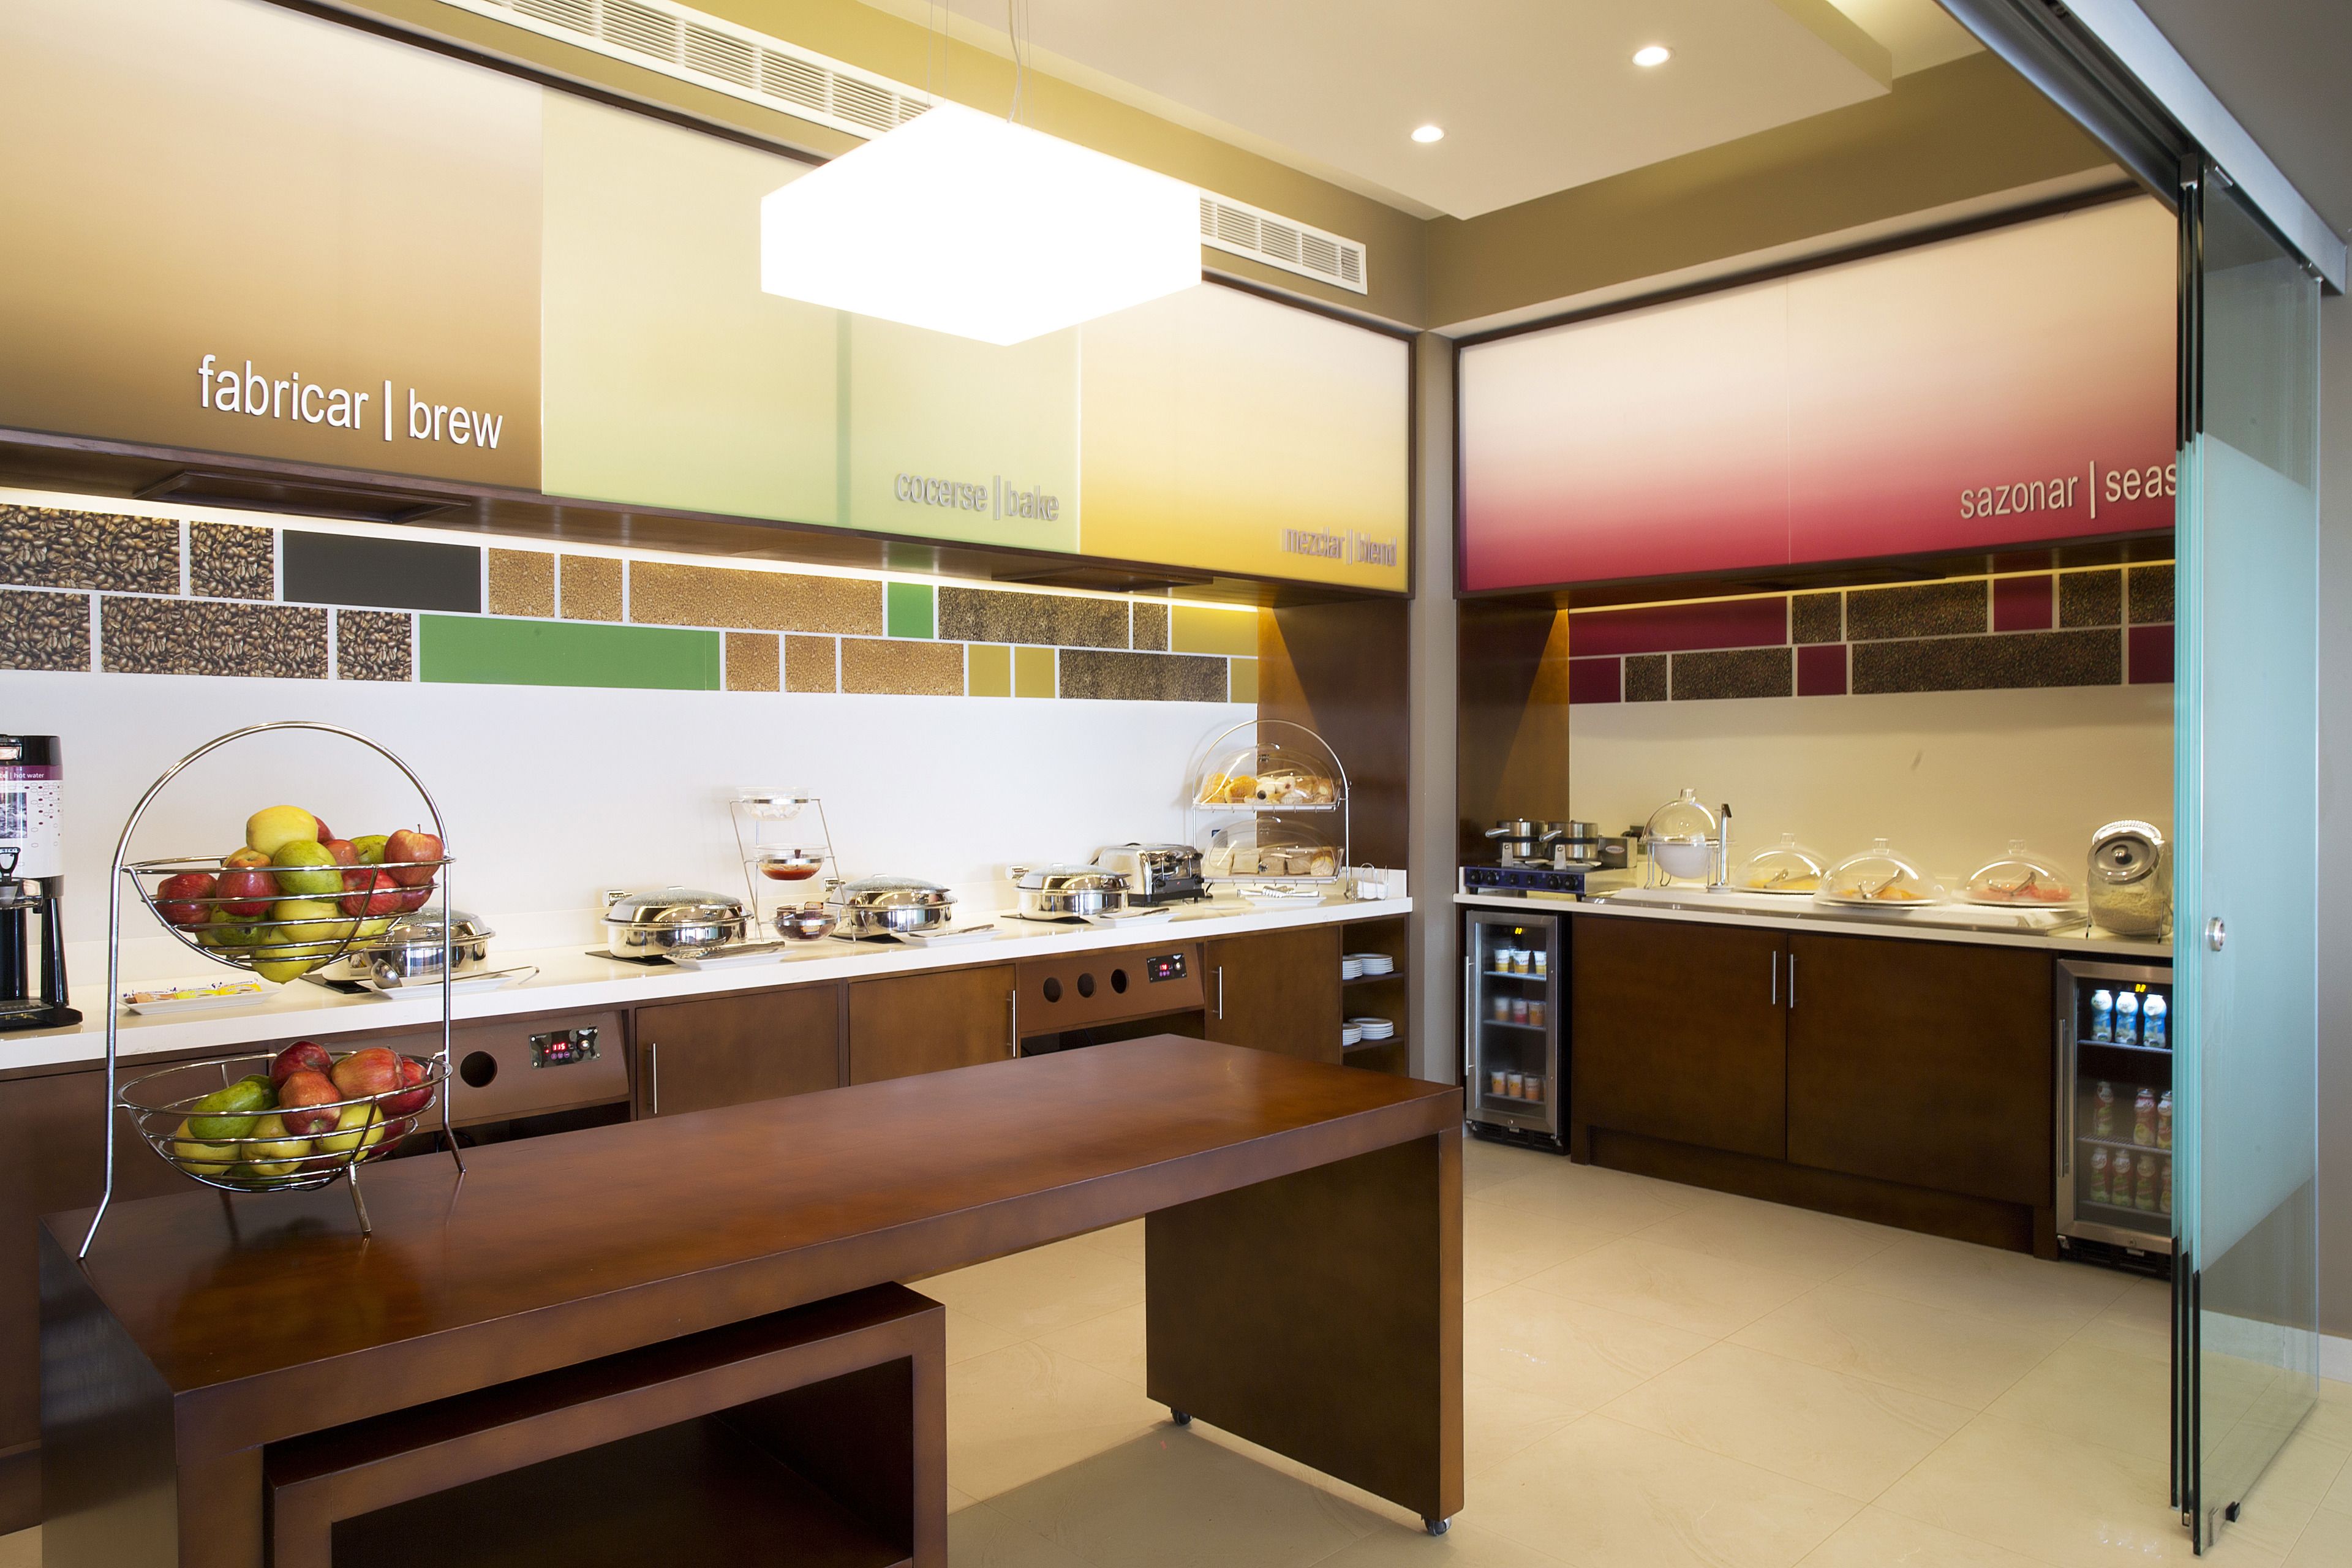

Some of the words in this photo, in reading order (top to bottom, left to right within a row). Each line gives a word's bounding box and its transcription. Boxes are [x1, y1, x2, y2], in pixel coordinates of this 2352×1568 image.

[198, 354, 369, 430] fabricar
[409, 388, 503, 449] brew
[895, 473, 988, 512] cocerse
[1005, 480, 1060, 521] bake
[1960, 475, 2079, 519] sazonar
[1281, 527, 1345, 559] mezclar
[1355, 532, 1396, 567] blend
